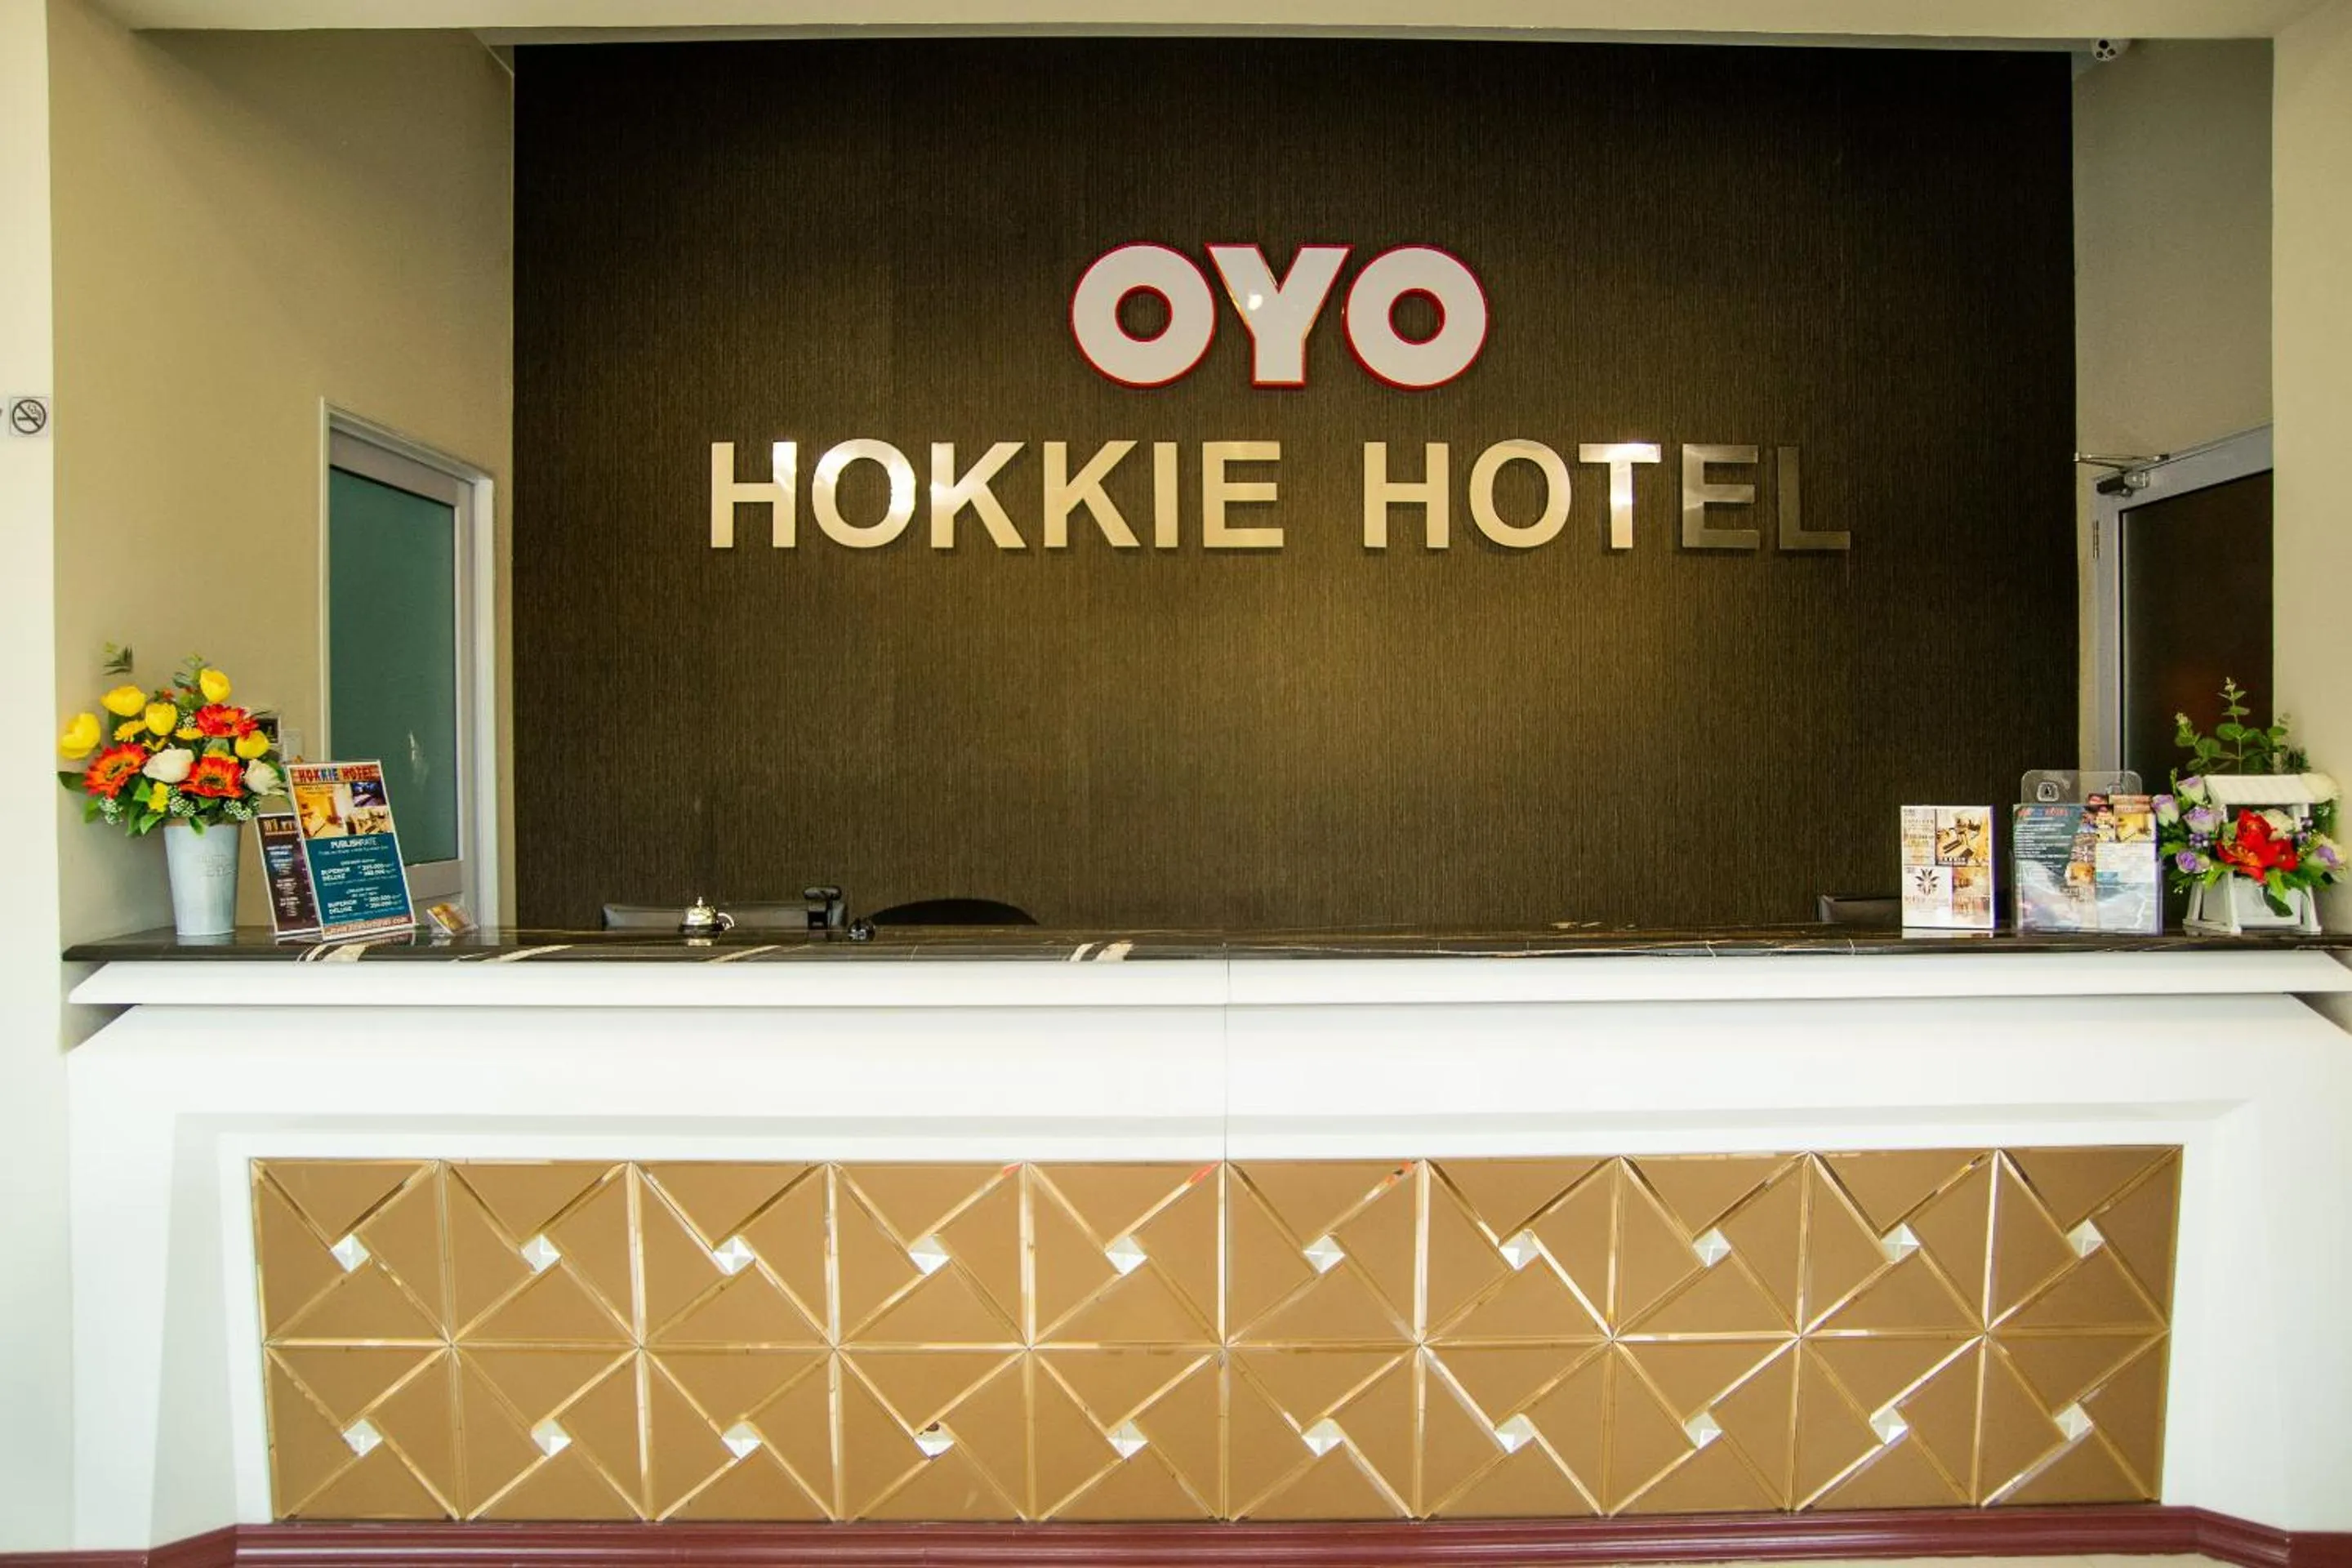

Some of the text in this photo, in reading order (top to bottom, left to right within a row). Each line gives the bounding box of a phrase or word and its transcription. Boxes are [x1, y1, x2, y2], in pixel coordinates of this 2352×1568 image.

[1071, 242, 1489, 390] OYO
[710, 438, 1852, 551] HOKKIE HOTEL
